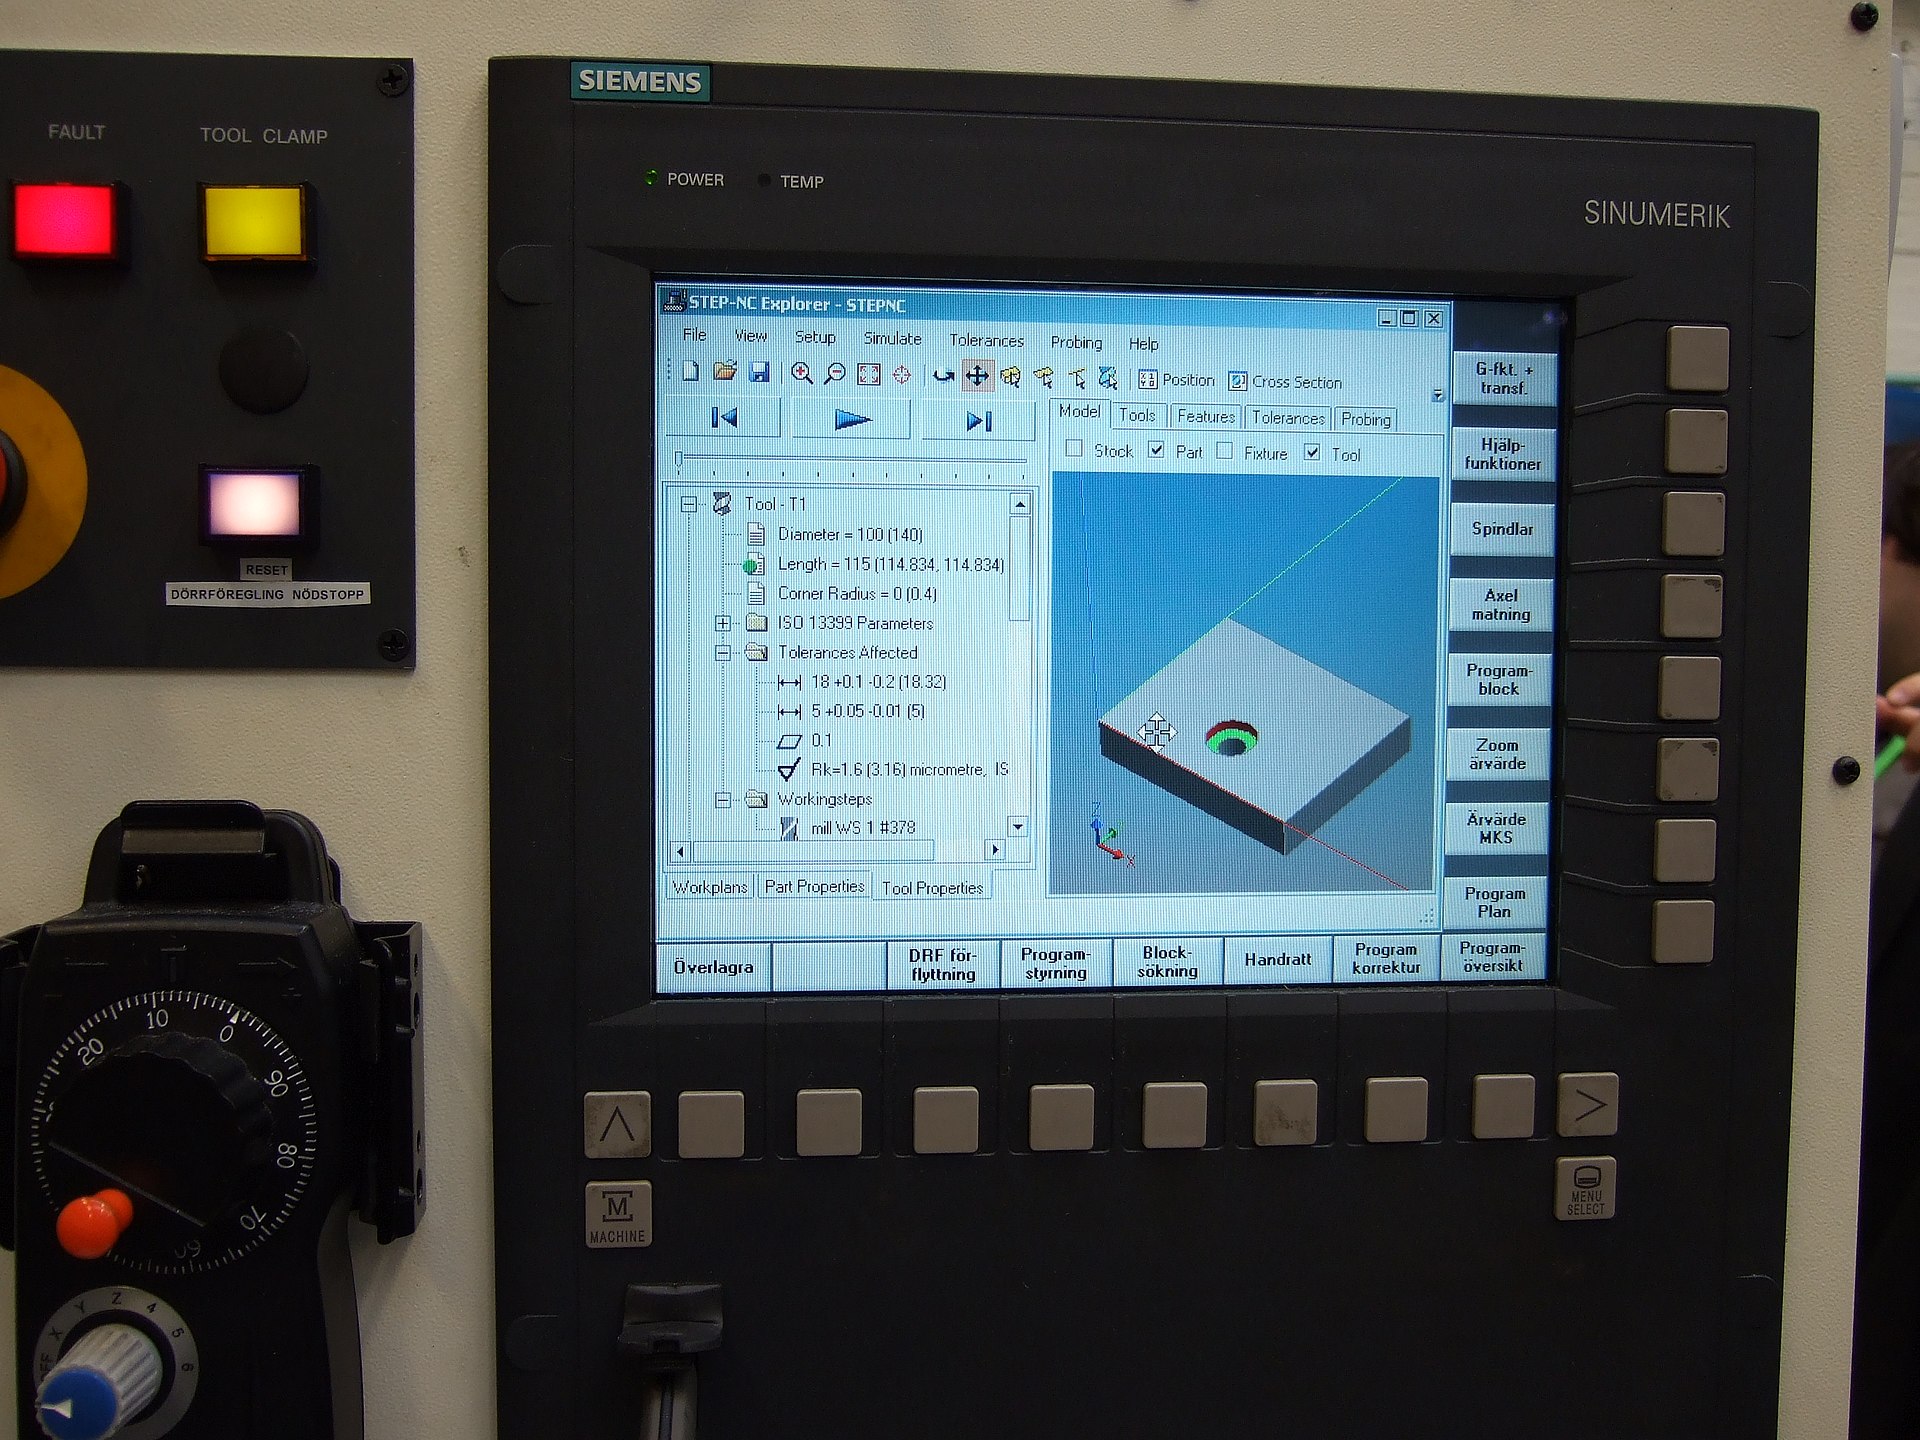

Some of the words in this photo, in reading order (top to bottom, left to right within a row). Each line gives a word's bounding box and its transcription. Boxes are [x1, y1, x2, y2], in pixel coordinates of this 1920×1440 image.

[579, 69, 702, 94] SIEMENS
[48, 124, 106, 141] FAULT
[200, 127, 252, 143] TOOL
[263, 128, 329, 145] CLAMP
[667, 172, 725, 187] POWER
[780, 175, 825, 189] TEMP
[1585, 199, 1731, 229] SINUMERIK
[689, 295, 757, 311] STEP-NC
[761, 296, 830, 313] Explorer
[846, 298, 906, 313] STEPNC
[683, 327, 707, 342] File
[735, 328, 768, 343] View
[795, 330, 837, 347] Setup
[864, 331, 922, 346] Simulate
[950, 333, 1025, 348] Tolerances
[1051, 335, 1103, 353] Probing
[1129, 337, 1160, 353] Help
[1476, 361, 1518, 376] G-fkt.
[1162, 373, 1216, 387] Position
[1253, 375, 1291, 390] Cross
[1295, 376, 1343, 391] Section
[1481, 380, 1528, 395] transf.
[1059, 404, 1101, 419] Model
[1119, 407, 1156, 422] Tools
[1178, 409, 1236, 424] Features
[1252, 410, 1326, 426] Tolerances
[1341, 412, 1392, 430] Probing
[1094, 443, 1134, 459] Stock
[1176, 445, 1203, 459] Part
[1244, 446, 1288, 461] Fixture
[1481, 437, 1526, 454] Hjälp-
[1333, 447, 1361, 462] Tool
[1465, 456, 1542, 471] funktioner
[745, 497, 776, 511] Tool
[789, 497, 806, 511] T1
[778, 527, 840, 541] Diameter
[857, 527, 884, 541] 100
[888, 527, 923, 544] (140)
[1472, 521, 1534, 538] Spindlar
[246, 564, 289, 576] RESET
[778, 557, 827, 573] Length
[845, 557, 870, 571] 115
[875, 557, 940, 574] (114.834,
[944, 558, 1004, 574] 114.834)
[171, 587, 284, 601] DÖRRFÖREGLING
[292, 587, 365, 600] NÖDSTOPP
[778, 586, 824, 601] Corner
[828, 586, 876, 601] Radius
[893, 586, 902, 601] 0
[906, 586, 938, 603] (0.4)
[1484, 588, 1518, 602] Axel
[1472, 607, 1532, 623] matning
[778, 617, 804, 631] ISO
[809, 616, 853, 630] 13399
[857, 617, 934, 631] Parameters
[779, 646, 855, 660] Tolerances
[858, 645, 918, 660] Affected
[1467, 663, 1534, 680] Program-
[812, 675, 830, 689] 18
[833, 675, 864, 689] +0.1
[868, 675, 895, 689] -0.2
[898, 675, 947, 691] (18.32)
[1479, 681, 1520, 696] block
[811, 704, 822, 718] 5
[825, 704, 864, 718] +0.05
[868, 704, 902, 718] -0.01
[906, 704, 926, 720] (5)
[811, 733, 833, 748] 0.1
[1476, 738, 1519, 752] Zoom
[811, 763, 863, 777] Rk=1.6
[866, 763, 907, 779] (3.16)
[910, 763, 988, 779] micrometre,
[995, 762, 1009, 776] IS
[1469, 756, 1527, 770] ärvärde
[777, 792, 873, 808] Workingsteps
[1467, 810, 1527, 826] Ärvärde
[811, 821, 832, 835] mill
[836, 821, 861, 835] WS
[867, 821, 874, 835] 1
[880, 820, 916, 835] #378
[1479, 831, 1514, 844] MKS
[672, 881, 748, 897] Workplans
[765, 879, 793, 894] Part
[797, 879, 865, 896] Properties
[882, 881, 912, 895] Tool
[916, 881, 984, 898] Properties
[1465, 886, 1526, 903] Program
[1478, 904, 1512, 918] Plan
[909, 948, 944, 964] DRF
[950, 947, 978, 963] för-
[1021, 947, 1092, 965] Program-
[1143, 945, 1193, 960] Block-
[1355, 941, 1418, 958] Program
[1459, 941, 1527, 958] Program-
[673, 957, 754, 976] Överlagra
[1244, 952, 1312, 967] Handratt
[1463, 958, 1524, 974] översikt
[912, 967, 976, 983] flyttning
[1025, 965, 1087, 982] styrning
[1137, 963, 1199, 980] sökning
[1352, 960, 1421, 976] korrektur
[147, 1009, 169, 1029] 10
[219, 1024, 234, 1043] 0
[77, 1037, 104, 1066] 20
[263, 1070, 289, 1098] 90
[276, 1142, 298, 1169] 80
[1571, 1190, 1603, 1202] MENU
[608, 1197, 628, 1216] M
[1567, 1203, 1606, 1216] SELECT
[239, 1205, 267, 1231] 70
[590, 1230, 646, 1244] MACHINE
[73, 1300, 86, 1314] Y
[111, 1292, 122, 1306] Z
[49, 1326, 63, 1340] X
